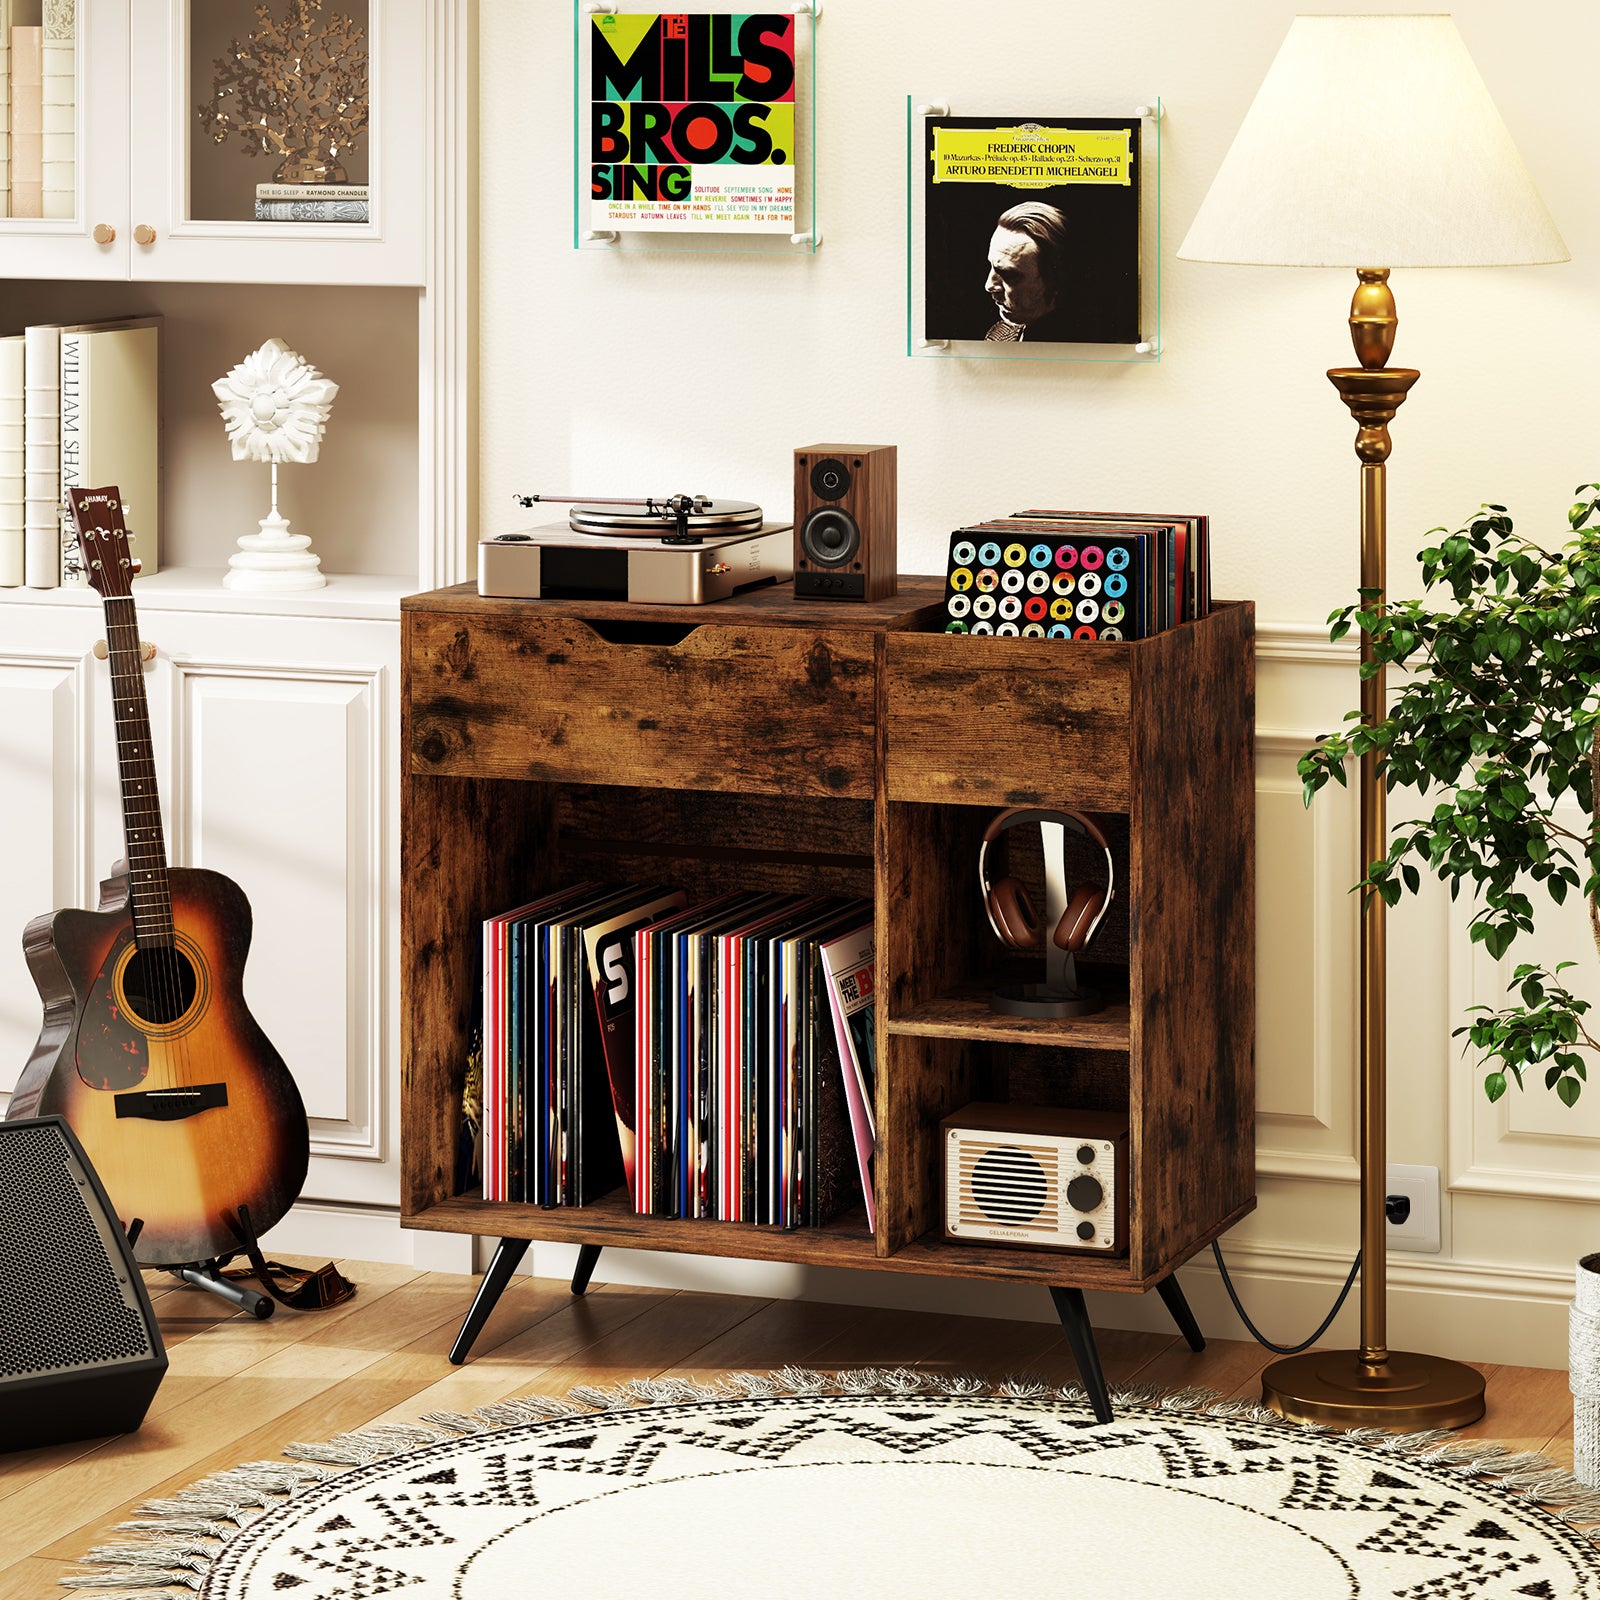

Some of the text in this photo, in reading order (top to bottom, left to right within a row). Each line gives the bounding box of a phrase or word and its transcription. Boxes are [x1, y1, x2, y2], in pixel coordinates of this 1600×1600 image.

[591, 14, 795, 102] MILLS
[591, 102, 786, 165] BROS.
[988, 143, 1075, 154] FREDERIC CHOPIN
[945, 165, 1118, 177] ARTURO BENEDETTI MICHELANGELI
[591, 165, 692, 201] SING
[730, 195, 762, 203] SOMETIMES
[63, 340, 79, 433] WILLIAM
[839, 974, 857, 990] MEET
[842, 985, 860, 1004] THE
